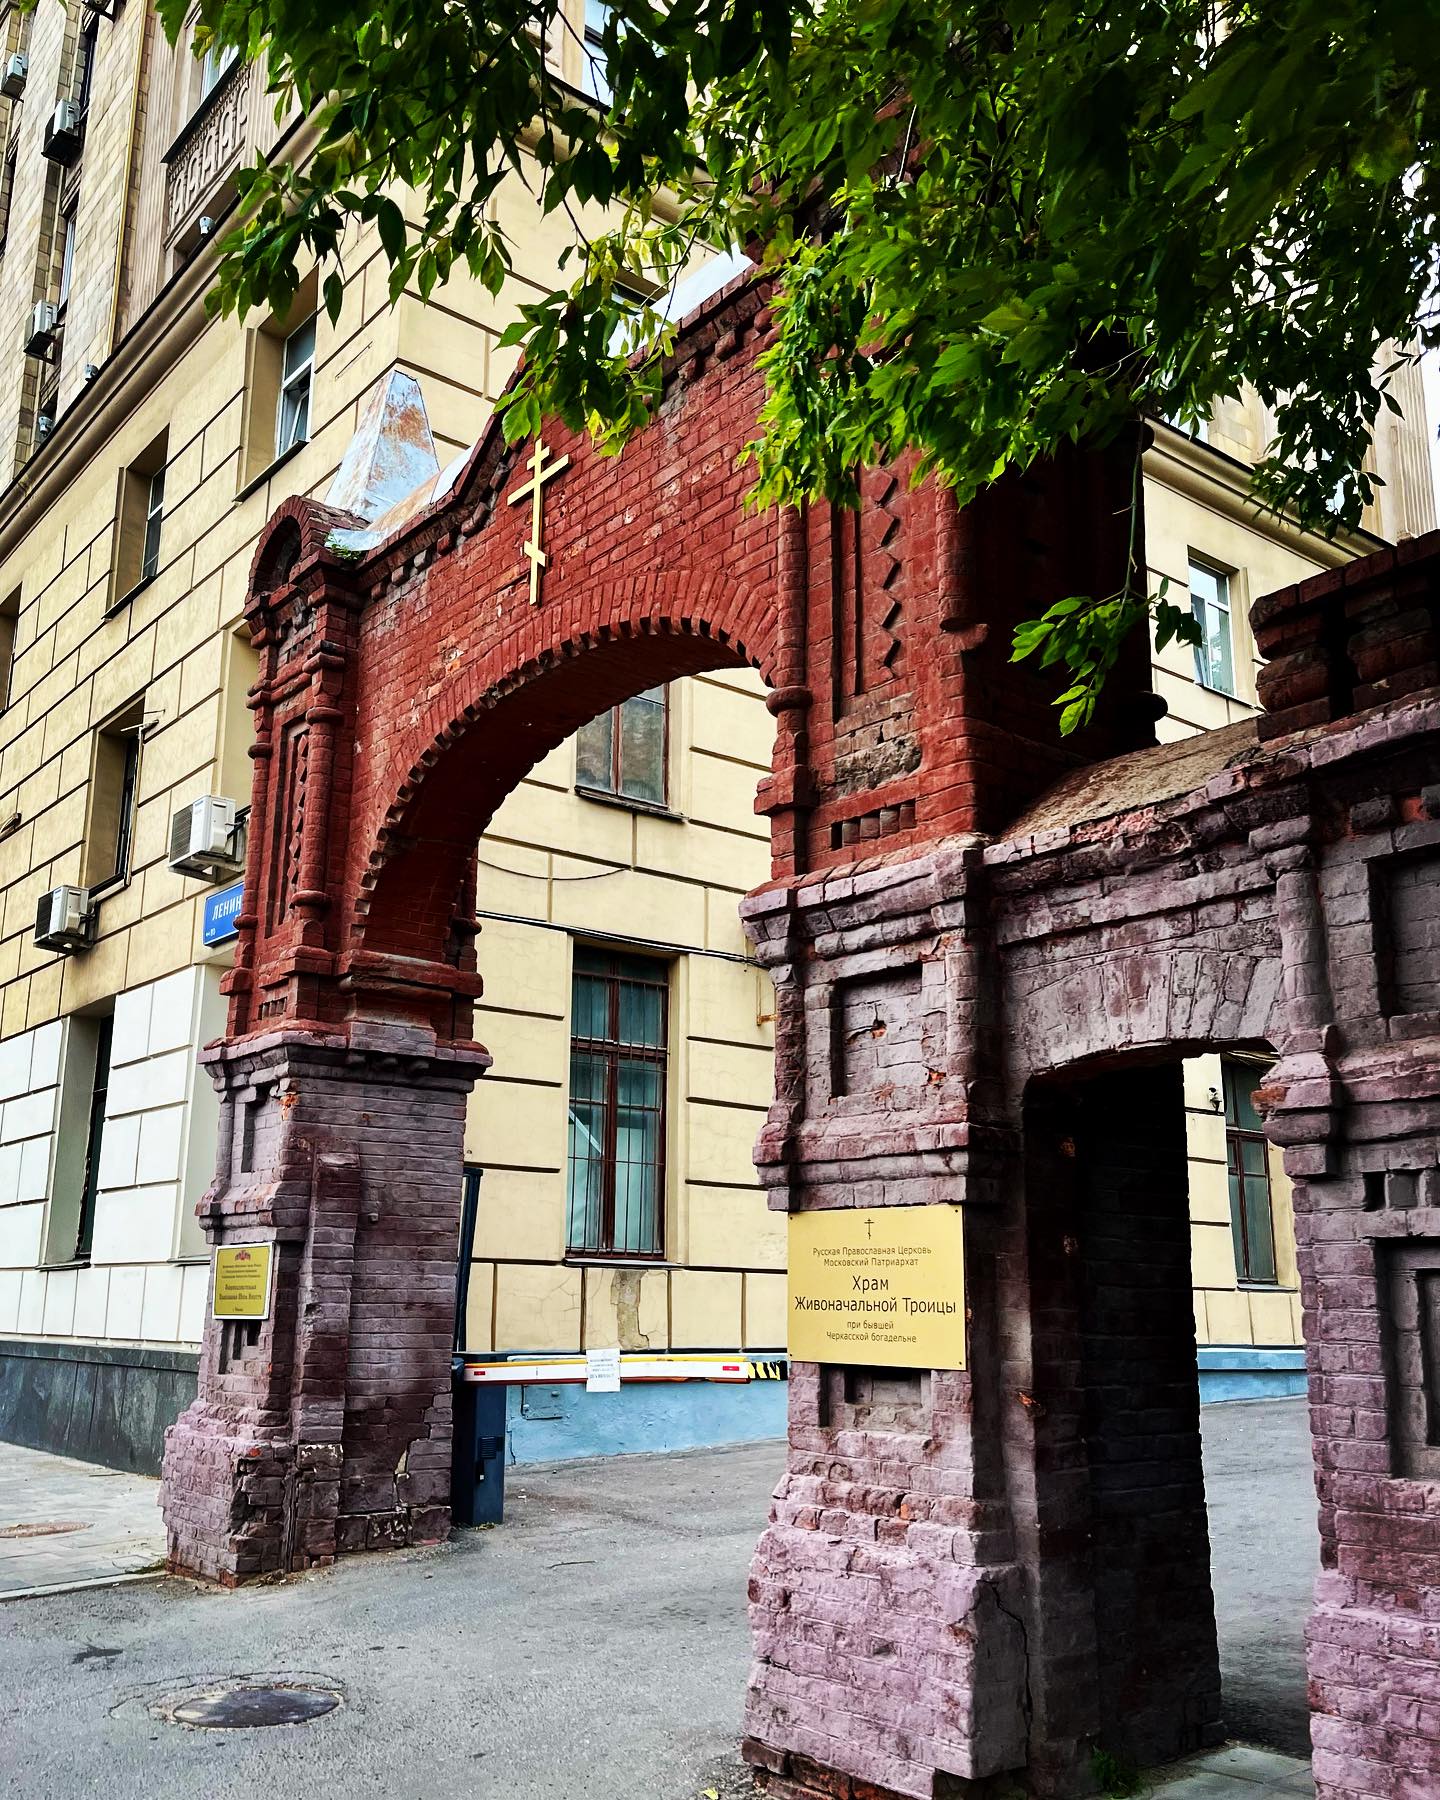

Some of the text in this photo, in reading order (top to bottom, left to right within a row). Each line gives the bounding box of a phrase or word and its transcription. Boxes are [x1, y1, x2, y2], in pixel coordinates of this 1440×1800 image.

[813, 1246, 932, 1257] Русская Православная Церковь
[824, 1258, 919, 1267] Московский Патриархат
[852, 1275, 889, 1294] Храм
[794, 1296, 956, 1316] Живоначальной Троицы
[847, 1320, 894, 1330] при бывшей
[826, 1331, 917, 1343] Черкасской богадельне
